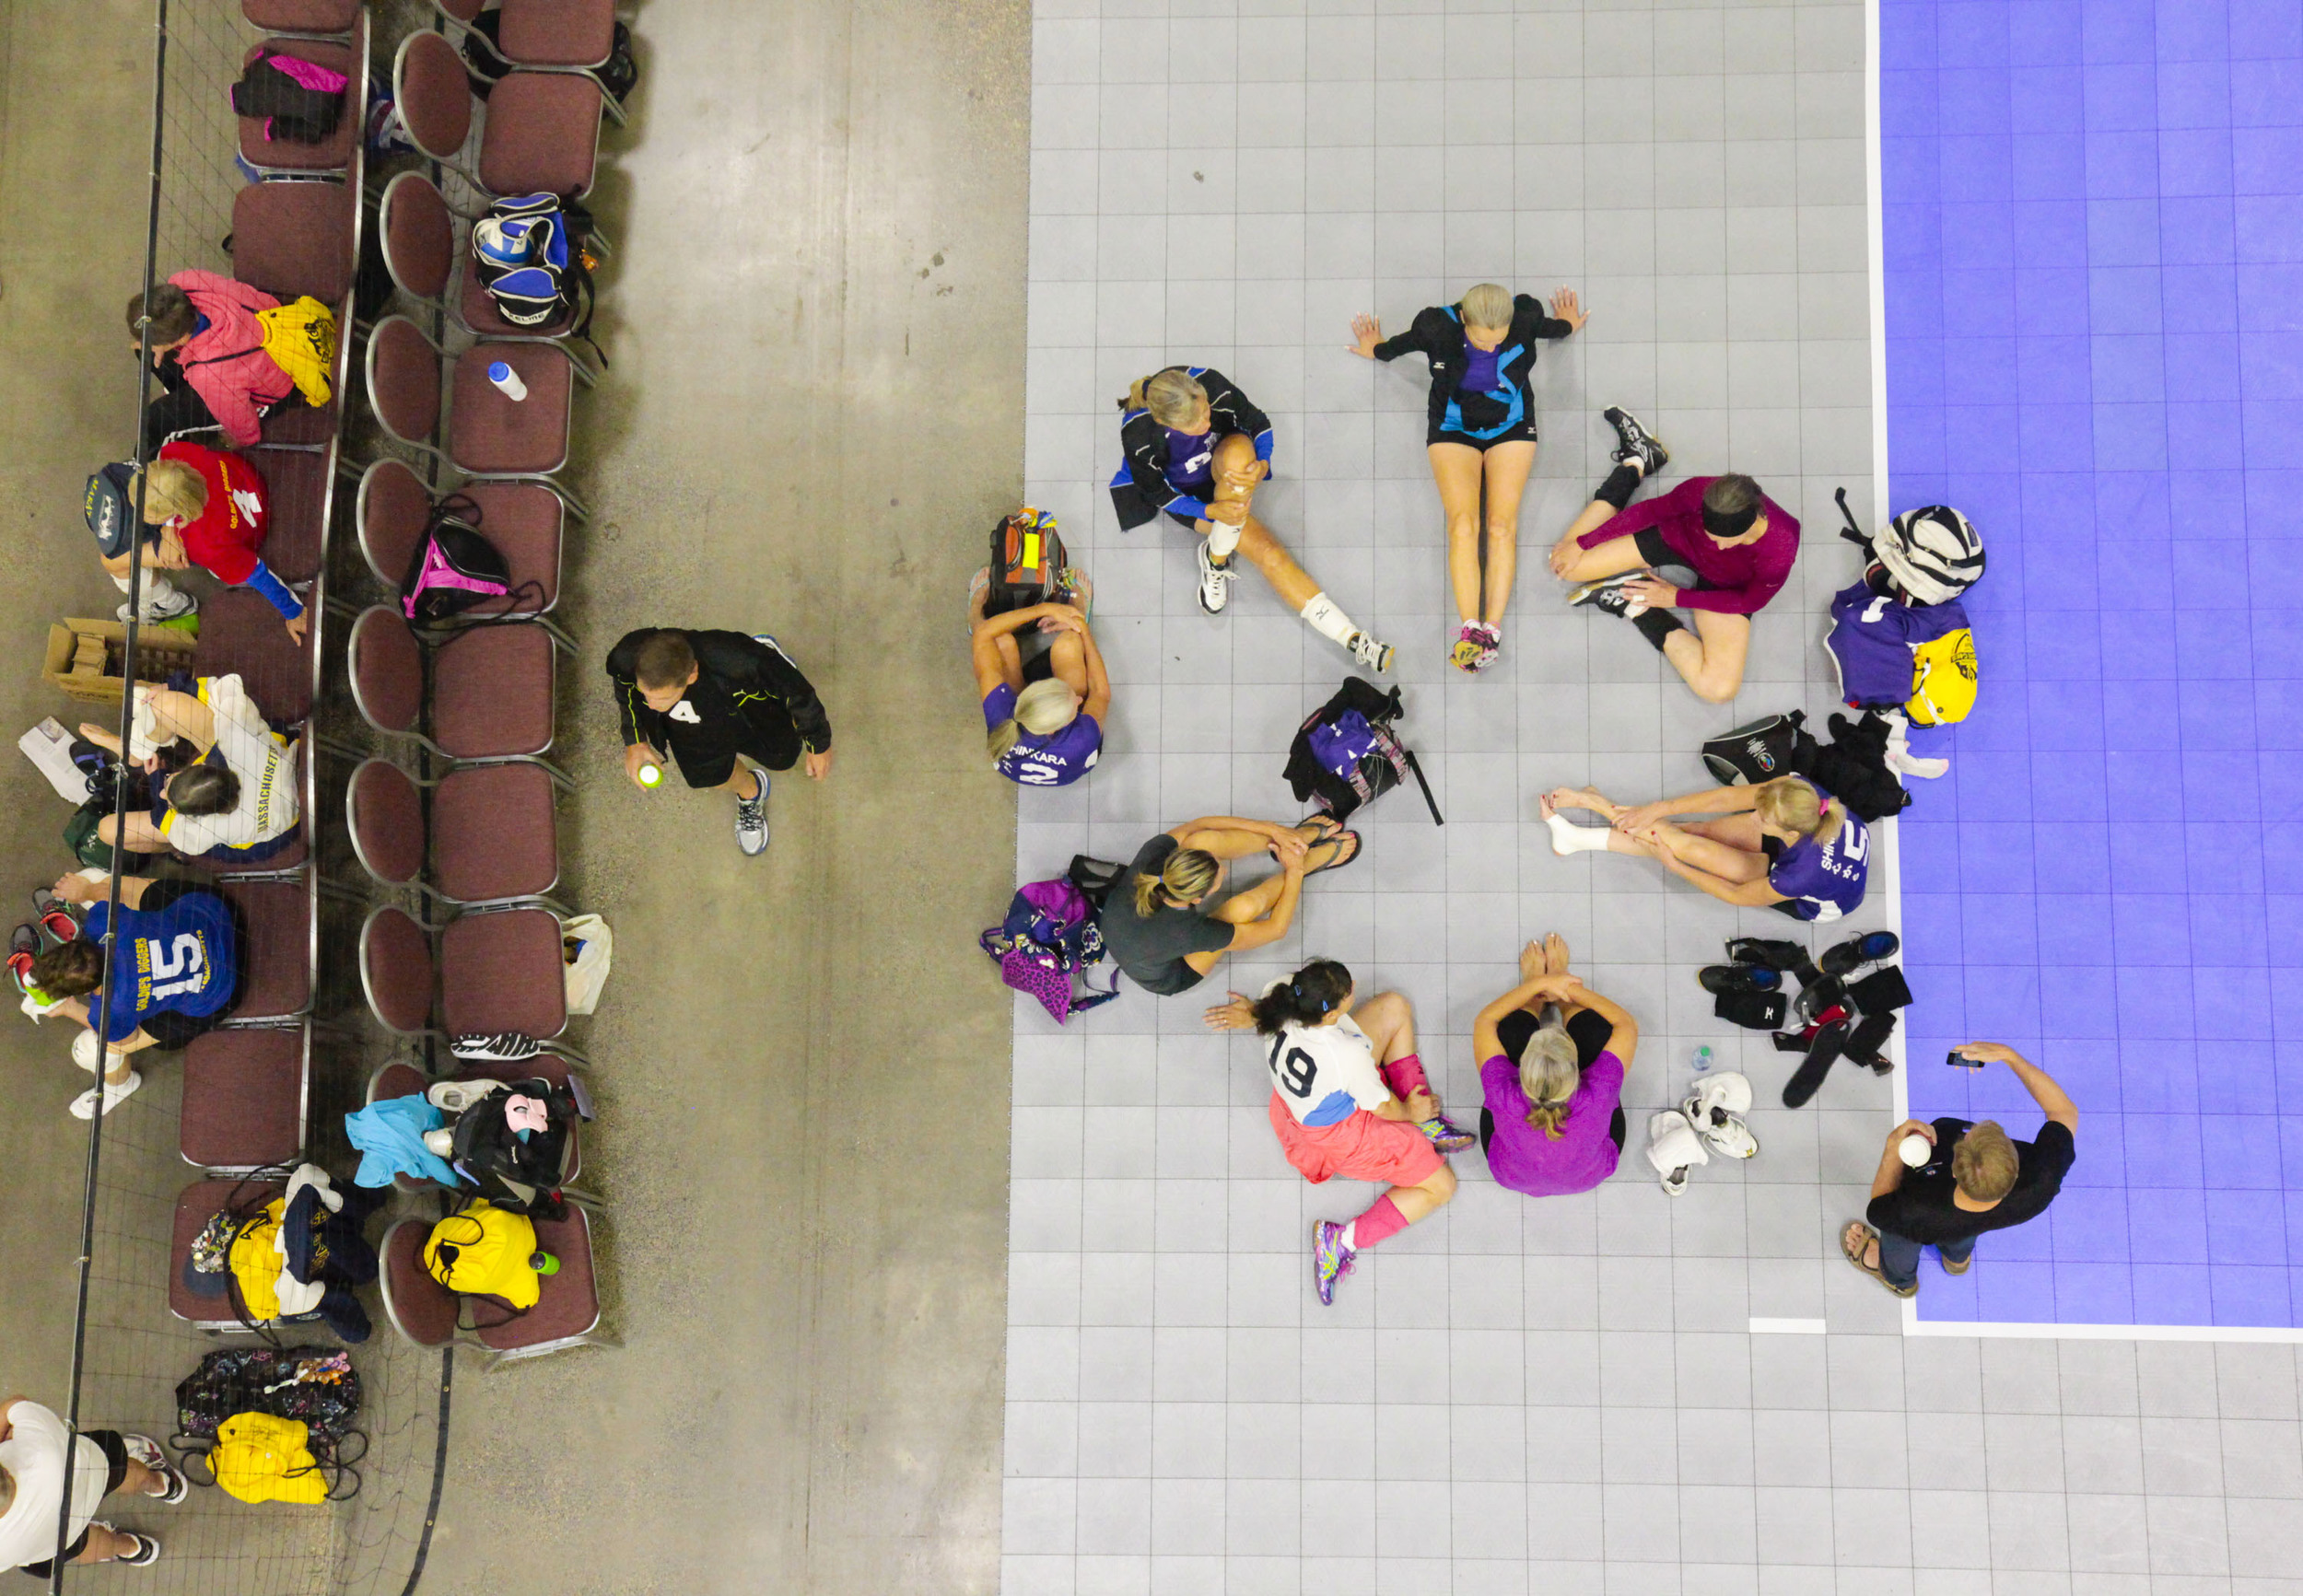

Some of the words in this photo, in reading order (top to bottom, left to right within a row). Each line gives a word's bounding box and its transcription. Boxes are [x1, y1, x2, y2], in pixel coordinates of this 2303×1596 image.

[509, 312, 545, 322] KELME
[668, 700, 702, 724] 4
[1010, 745, 1068, 766] HINKARA
[1019, 763, 1058, 785] 2
[1843, 819, 1870, 868] 5
[134, 938, 150, 973] DIGGERS
[148, 933, 204, 1001] 15
[135, 976, 152, 1011] GOLDIE'S
[1268, 1030, 1318, 1099] 19
